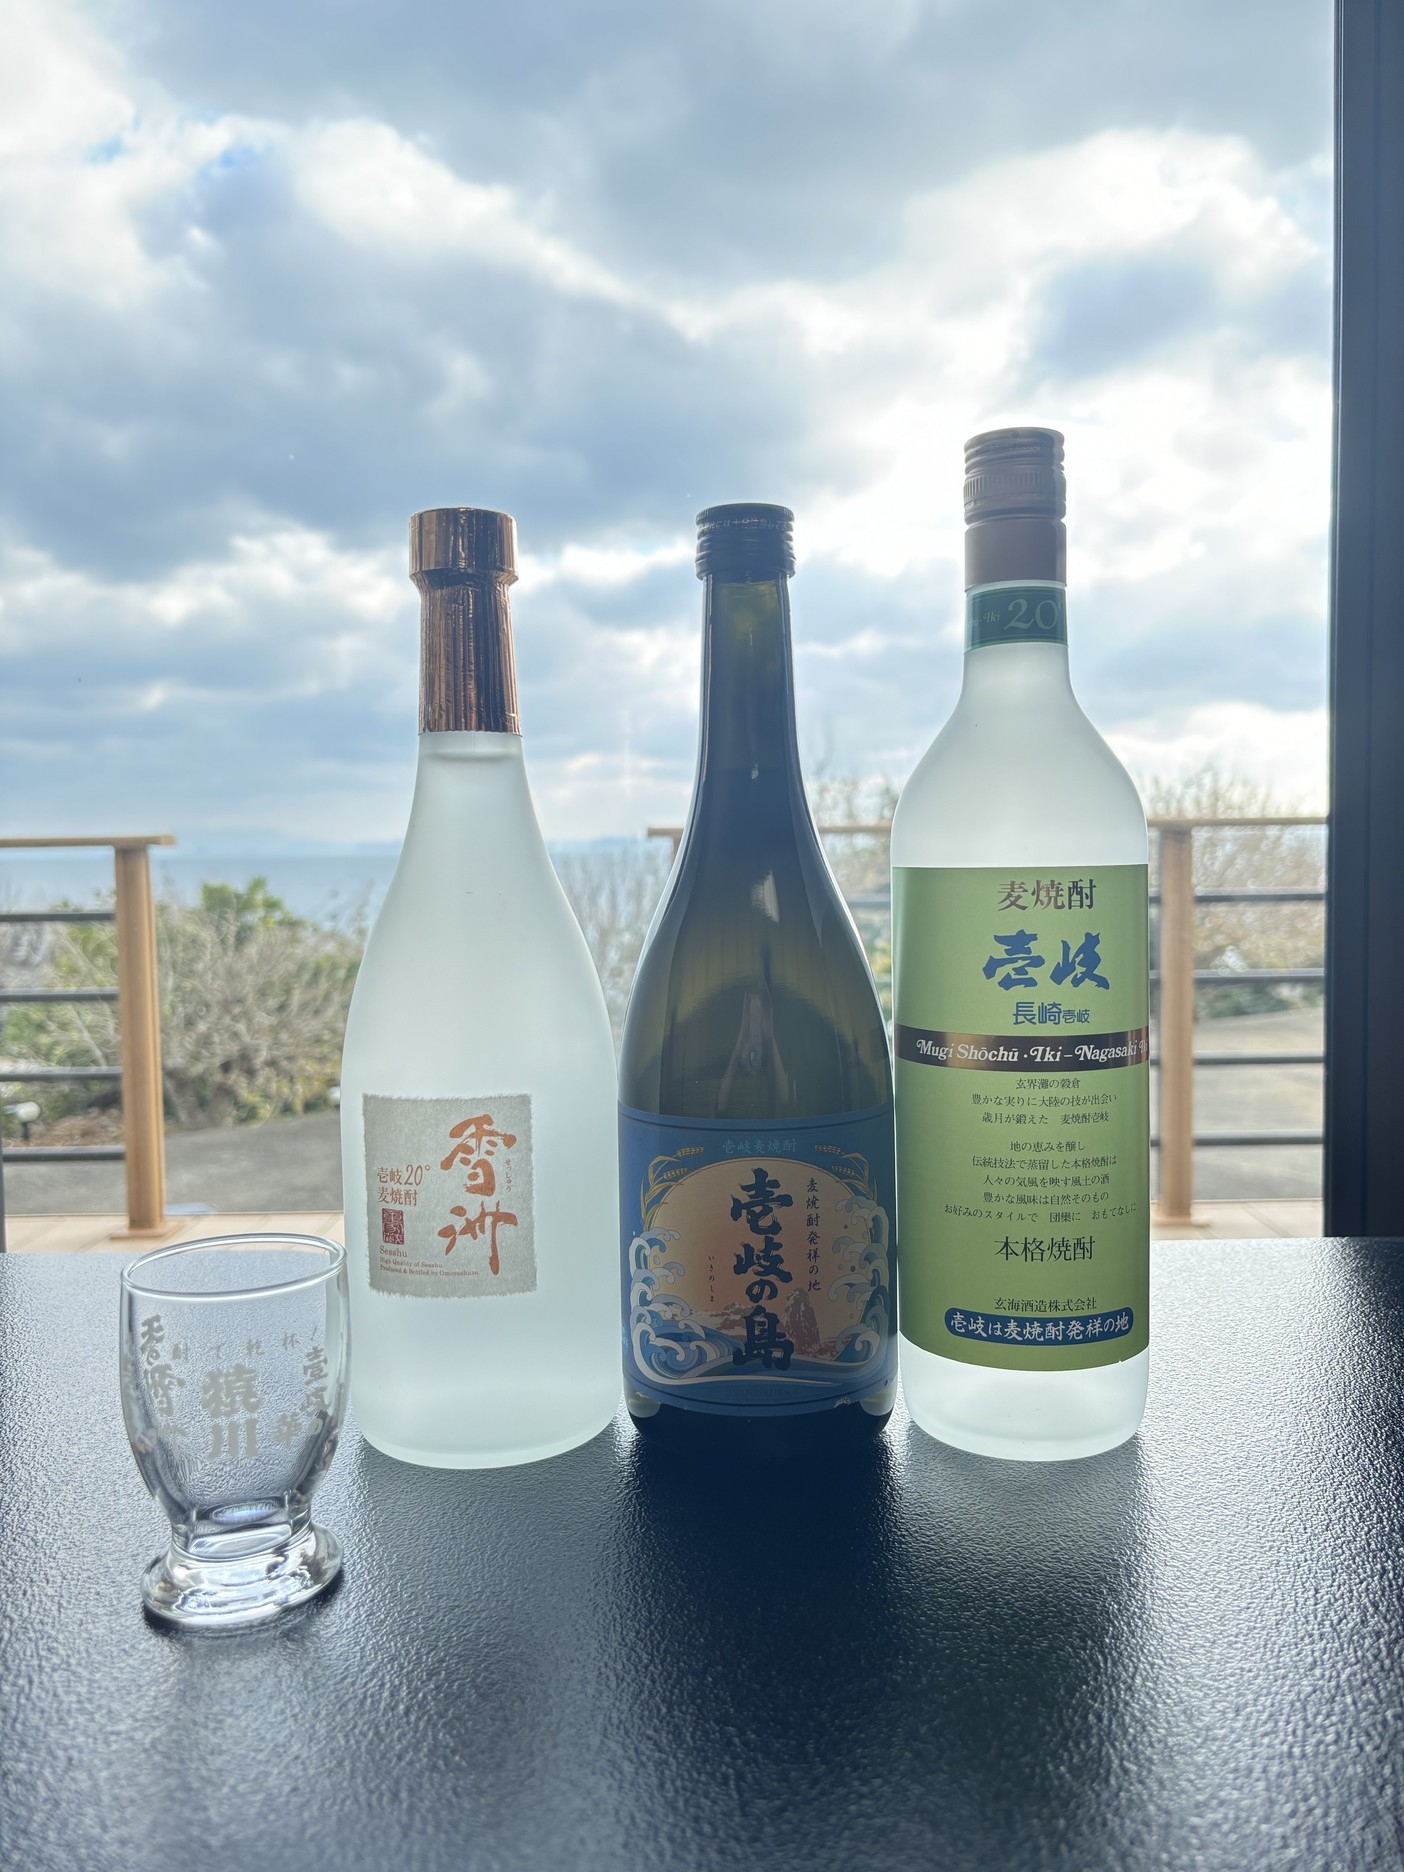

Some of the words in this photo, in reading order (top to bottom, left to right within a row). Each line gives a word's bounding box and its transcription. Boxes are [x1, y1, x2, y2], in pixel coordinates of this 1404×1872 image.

[997, 878, 1097, 911] 麦焼酎
[982, 929, 1110, 991] 壱岐
[1013, 1001, 1091, 1026] 長崎壱岐
[916, 1039, 954, 1061] Mugi
[956, 1043, 1019, 1062] Shōchū
[1075, 1040, 1138, 1064] Nagasaki
[1015, 1077, 1081, 1090] 玄界灘の穀倉
[981, 1112, 1049, 1125] 歳月が鍛えた
[1060, 1111, 1109, 1125] 麦焼酎壱岐
[721, 1137, 797, 1154] 壱岐麦焼酎
[1010, 1140, 1086, 1153] 地の恵みを醸し
[972, 1155, 1117, 1171] 伝統技法で蒸留した本格焼酎は
[983, 1173, 1110, 1189] 人々の気風を映す風土の酒
[378, 1186, 418, 1206] 麦焼酎
[983, 1191, 1109, 1206] 豊かな風味は自然そのもの
[944, 1203, 1039, 1223] お好みのスタイルで
[1091, 1202, 1137, 1220] おもてなしに
[806, 1178, 822, 1292] 麦焼酎発祥の地
[379, 1246, 408, 1258] Sesshu
[994, 1236, 1096, 1262] 本格焼酎
[729, 1167, 794, 1371] 壱岐の島
[994, 1297, 1097, 1312] 玄海酒造株式会社
[950, 1311, 1129, 1342] 壱岐は麦焼酎発祥の地
